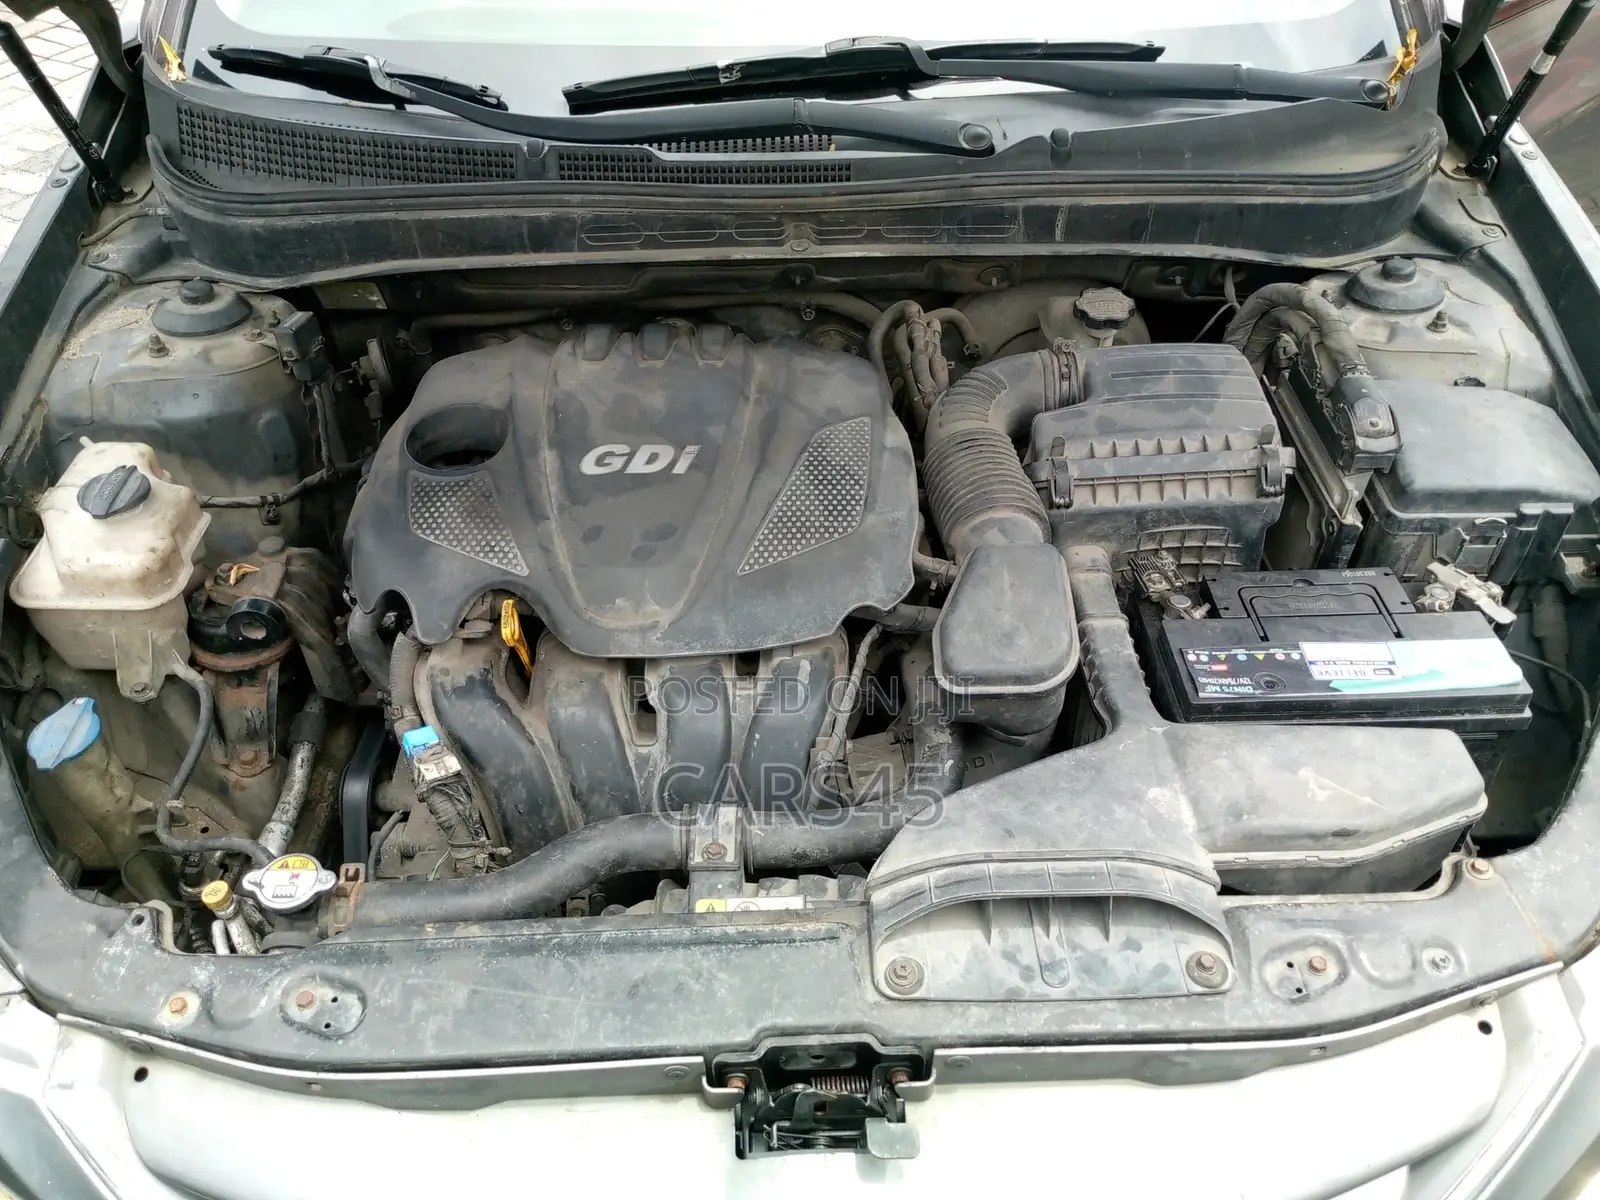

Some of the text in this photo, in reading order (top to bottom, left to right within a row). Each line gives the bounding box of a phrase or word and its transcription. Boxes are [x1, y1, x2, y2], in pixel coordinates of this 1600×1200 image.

[579, 443, 702, 475] GDi
[1317, 668, 1367, 678] BELIEVE
[1204, 684, 1221, 694] MF
